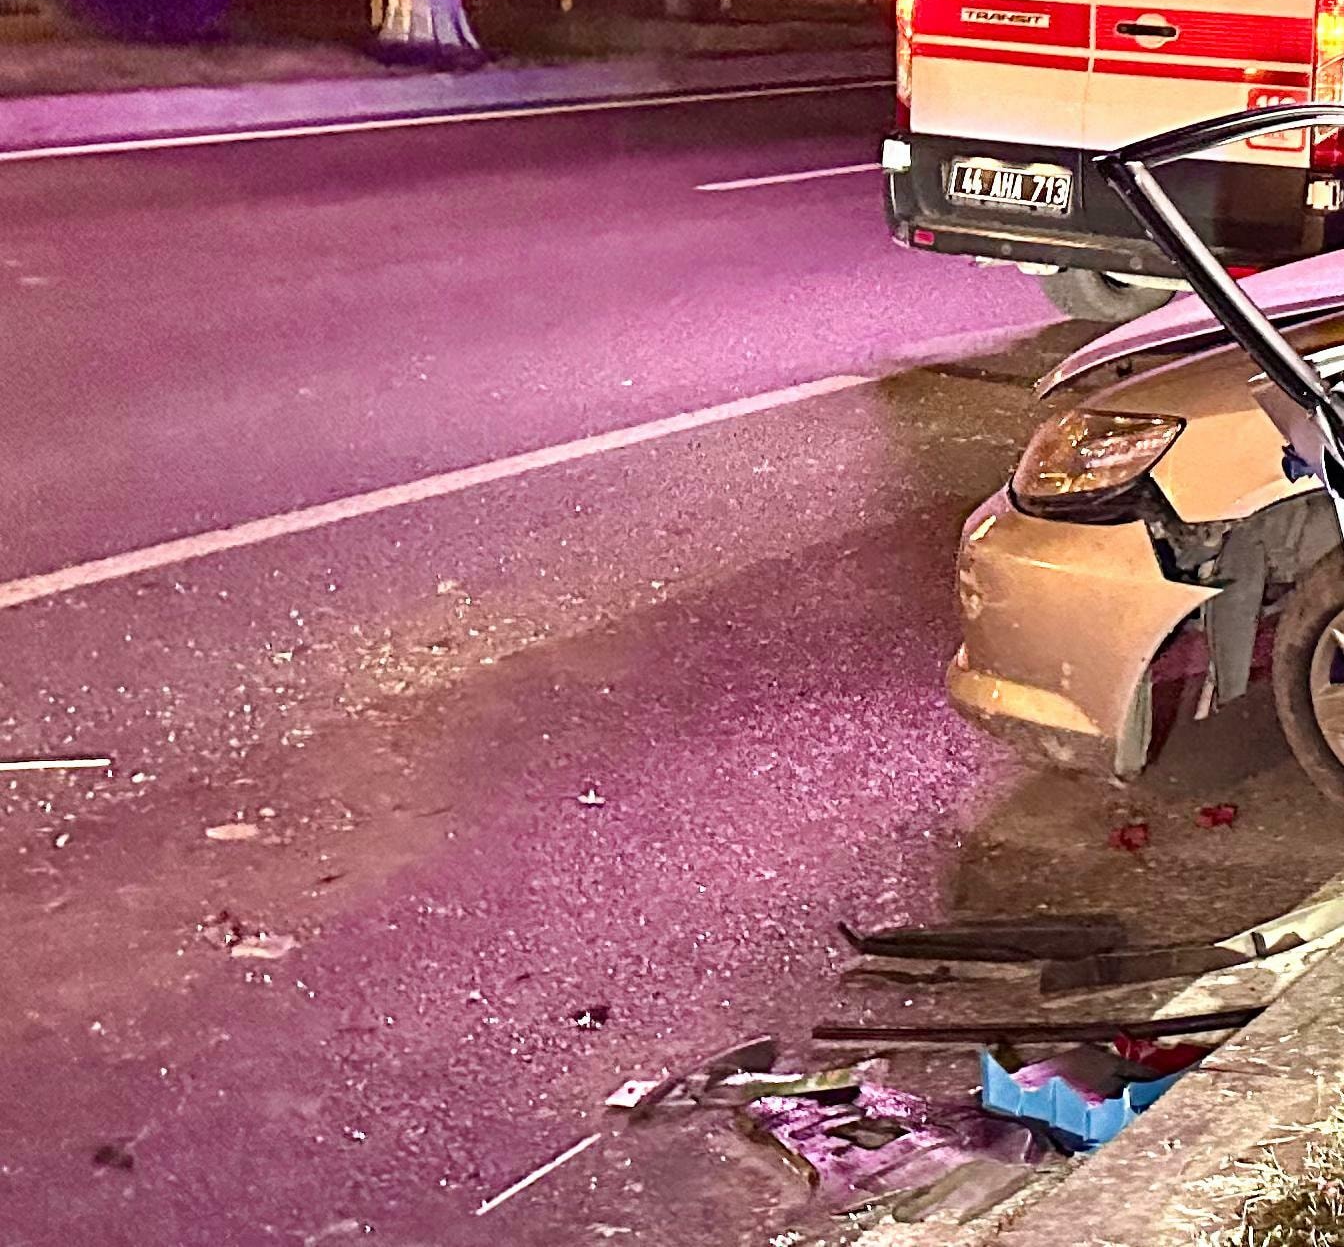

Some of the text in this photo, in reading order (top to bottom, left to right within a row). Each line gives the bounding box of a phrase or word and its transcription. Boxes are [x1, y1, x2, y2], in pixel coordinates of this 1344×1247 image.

[961, 167, 1067, 205] 44 AHA 713
